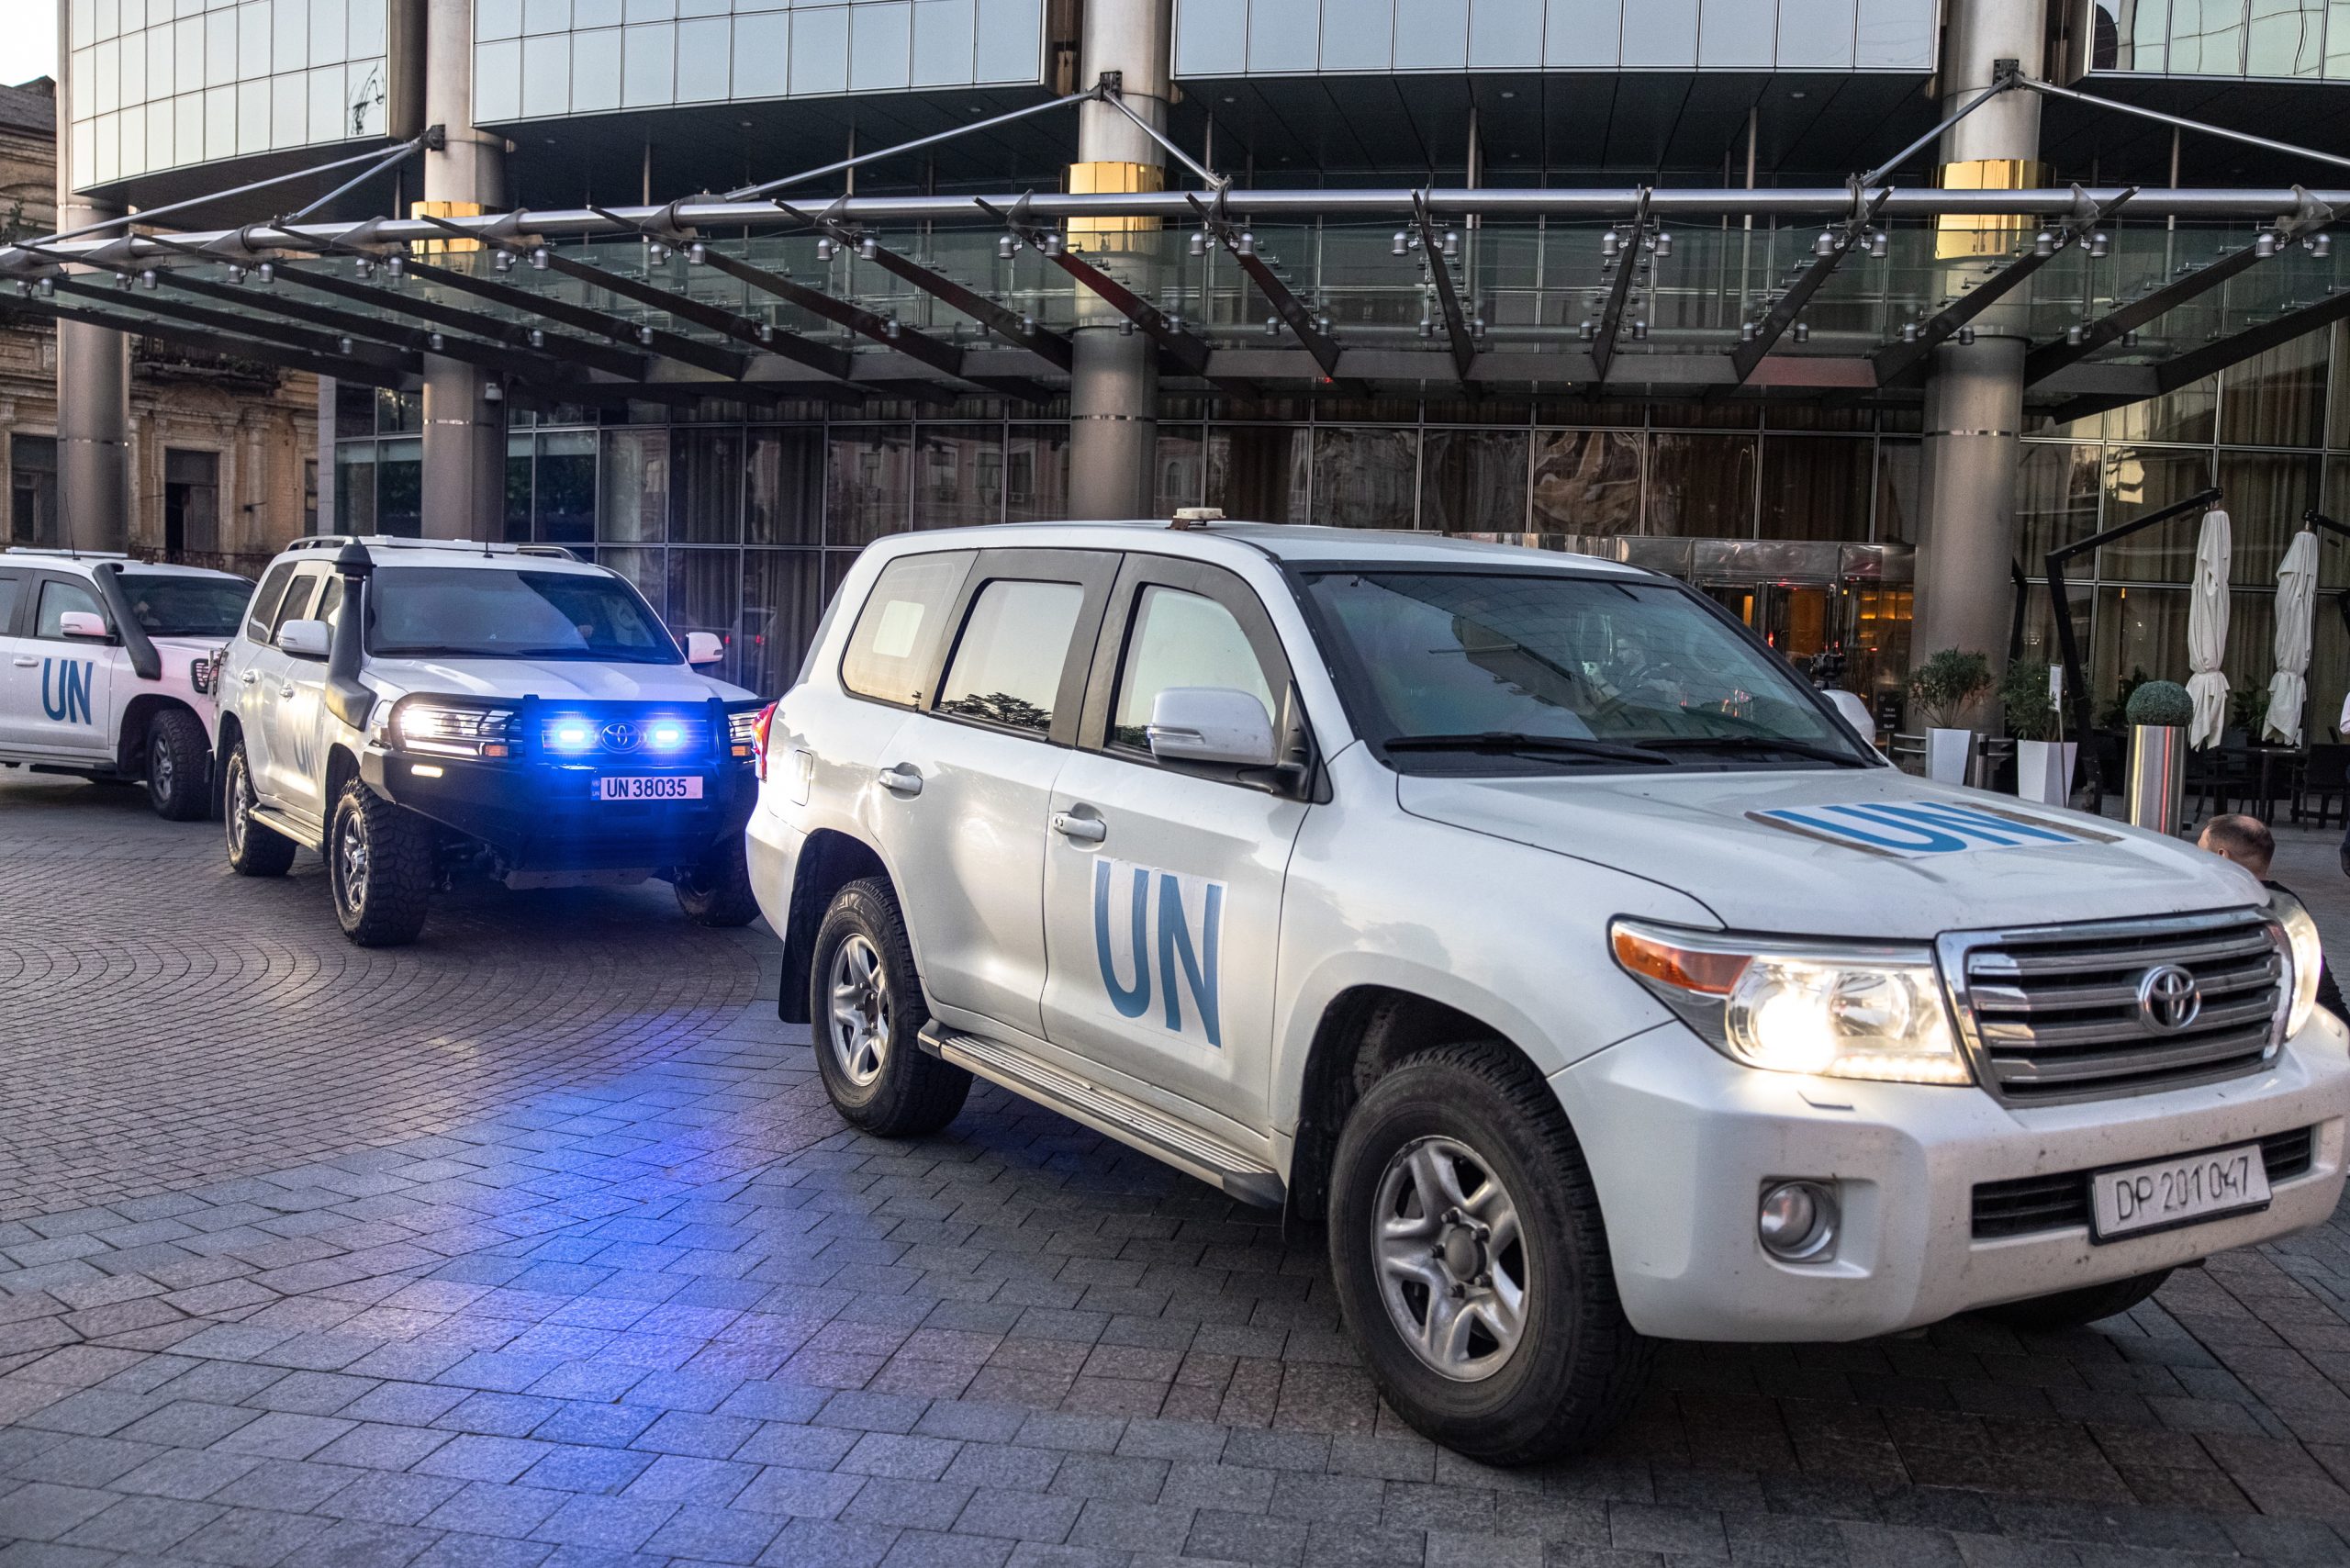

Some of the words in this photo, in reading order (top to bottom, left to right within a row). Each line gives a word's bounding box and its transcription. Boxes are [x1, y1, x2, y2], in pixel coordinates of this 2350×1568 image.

[42, 658, 93, 725] UN
[608, 779, 629, 797] UN
[633, 778, 687, 797] 38035
[1761, 802, 2078, 852] UN
[1095, 860, 1223, 1048] UN
[2116, 1176, 2154, 1220] DP
[2160, 1164, 2201, 1211] 201
[2209, 1156, 2248, 1199] 047
